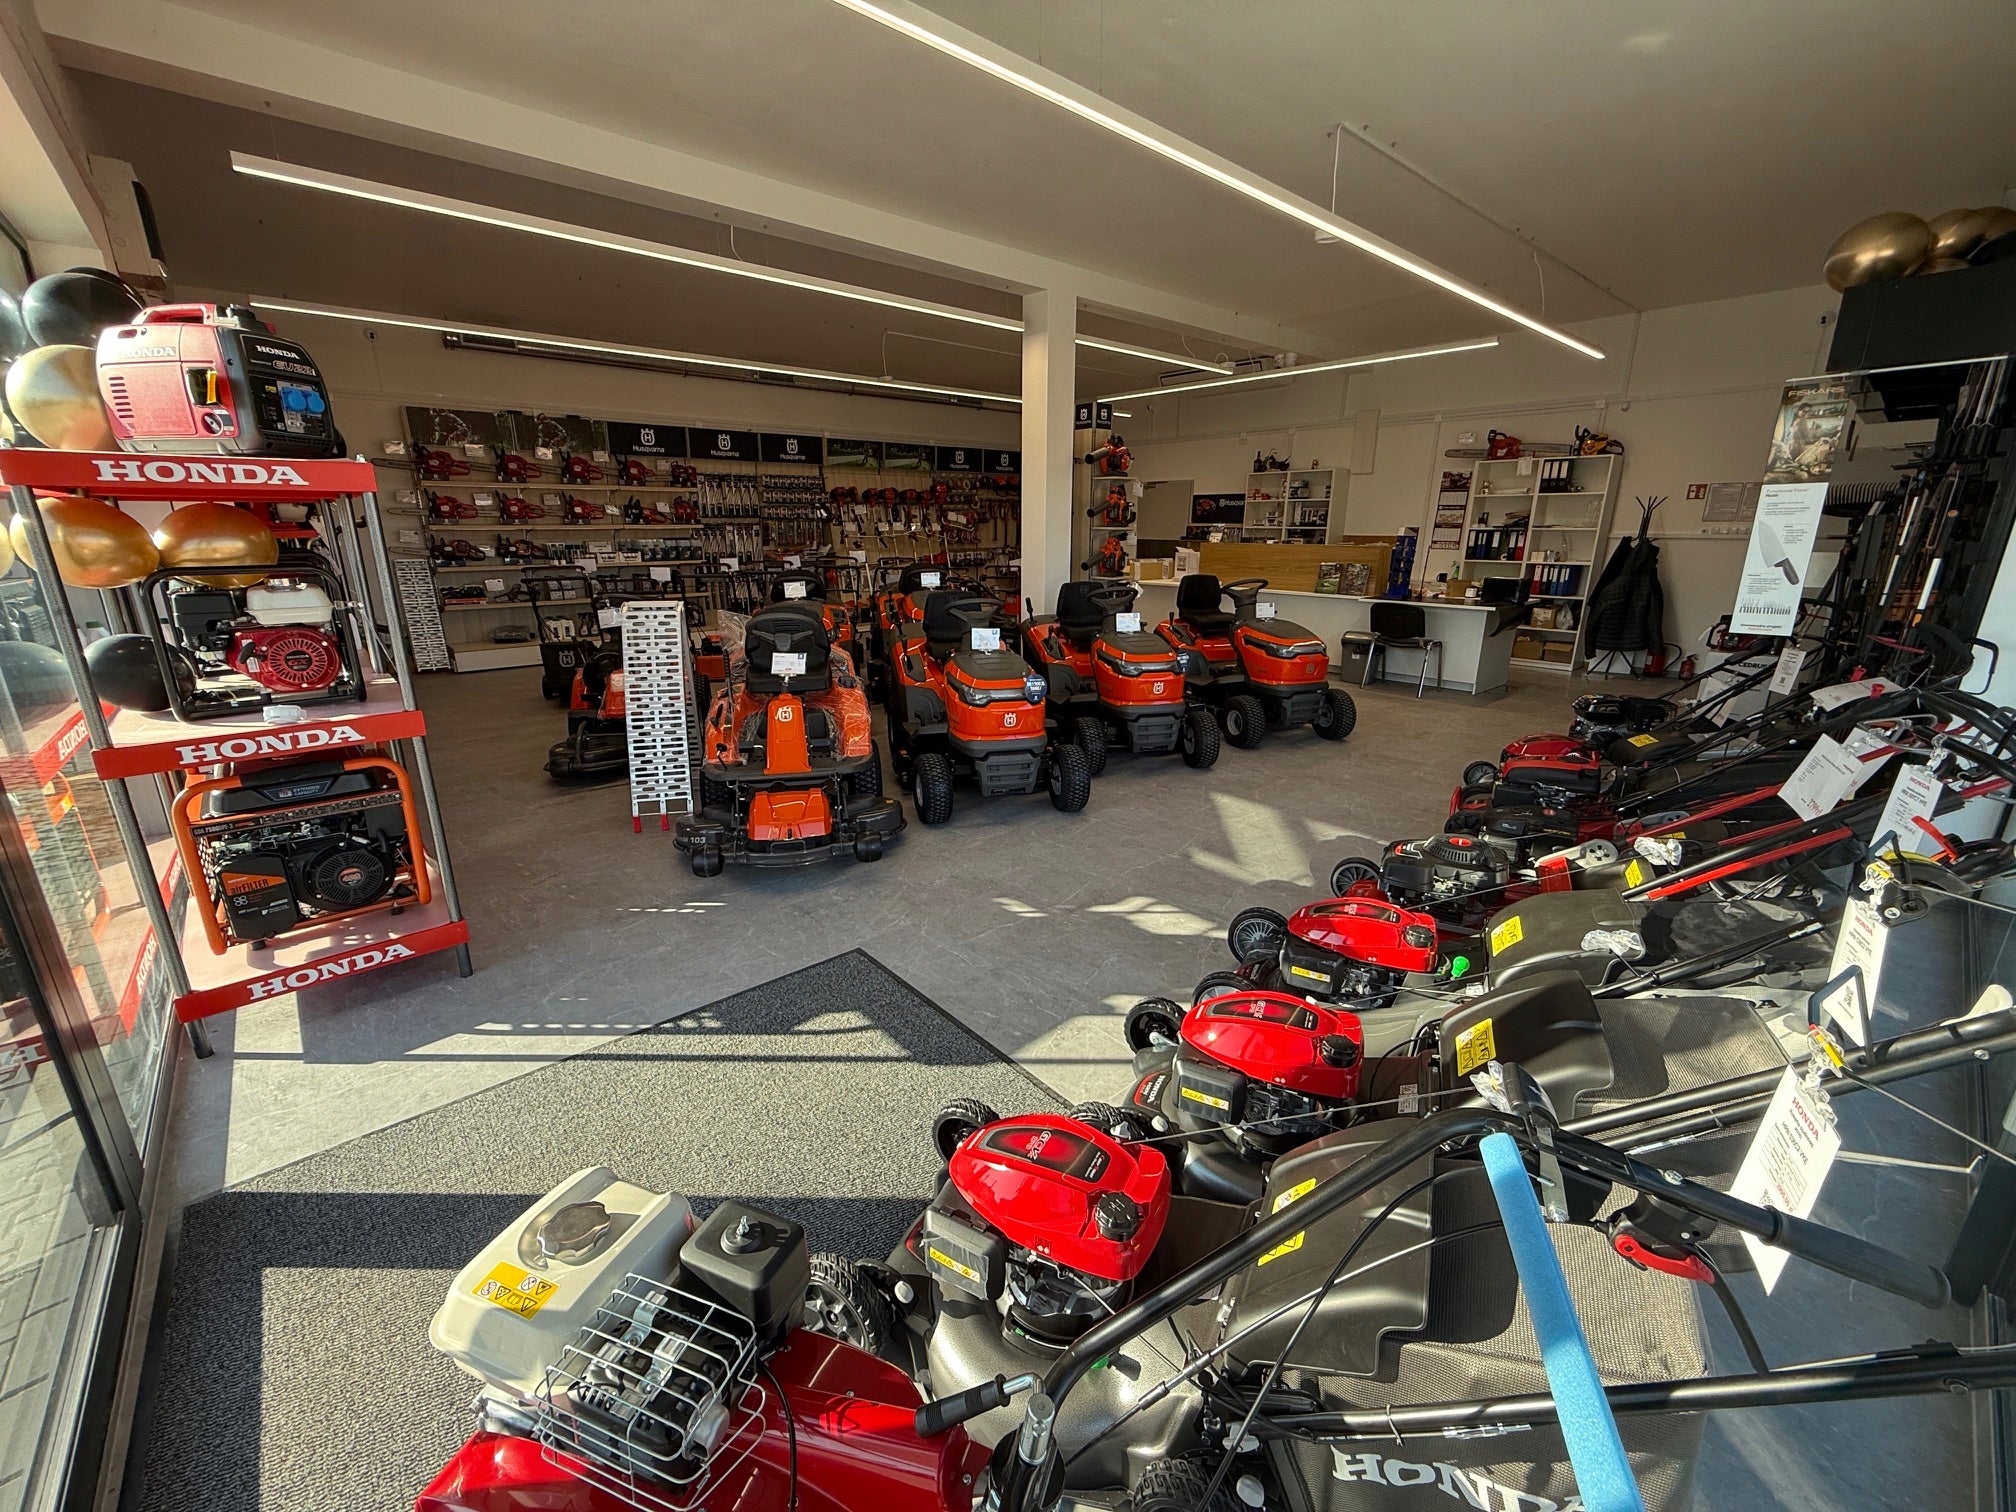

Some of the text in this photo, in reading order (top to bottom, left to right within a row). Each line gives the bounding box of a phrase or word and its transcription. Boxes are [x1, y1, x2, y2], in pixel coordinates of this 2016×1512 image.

[255, 344, 301, 360] HONDA
[1788, 385, 1846, 398] FISKARS
[632, 444, 665, 454] Husqvarna
[710, 449, 740, 458] Husqvarna
[779, 453, 806, 461] Husqvarna
[91, 459, 310, 486] HONDA
[1224, 498, 1246, 507] Husqvar
[175, 725, 366, 765] HONDA
[1909, 775, 1931, 792] HONDA
[689, 836, 706, 844] 103
[230, 878, 270, 895] airFILTER
[1854, 914, 1874, 937] HONDA
[246, 943, 416, 1000] HONDA
[1146, 1074, 1167, 1104] HONDA
[1791, 1096, 1819, 1142] HONDA
